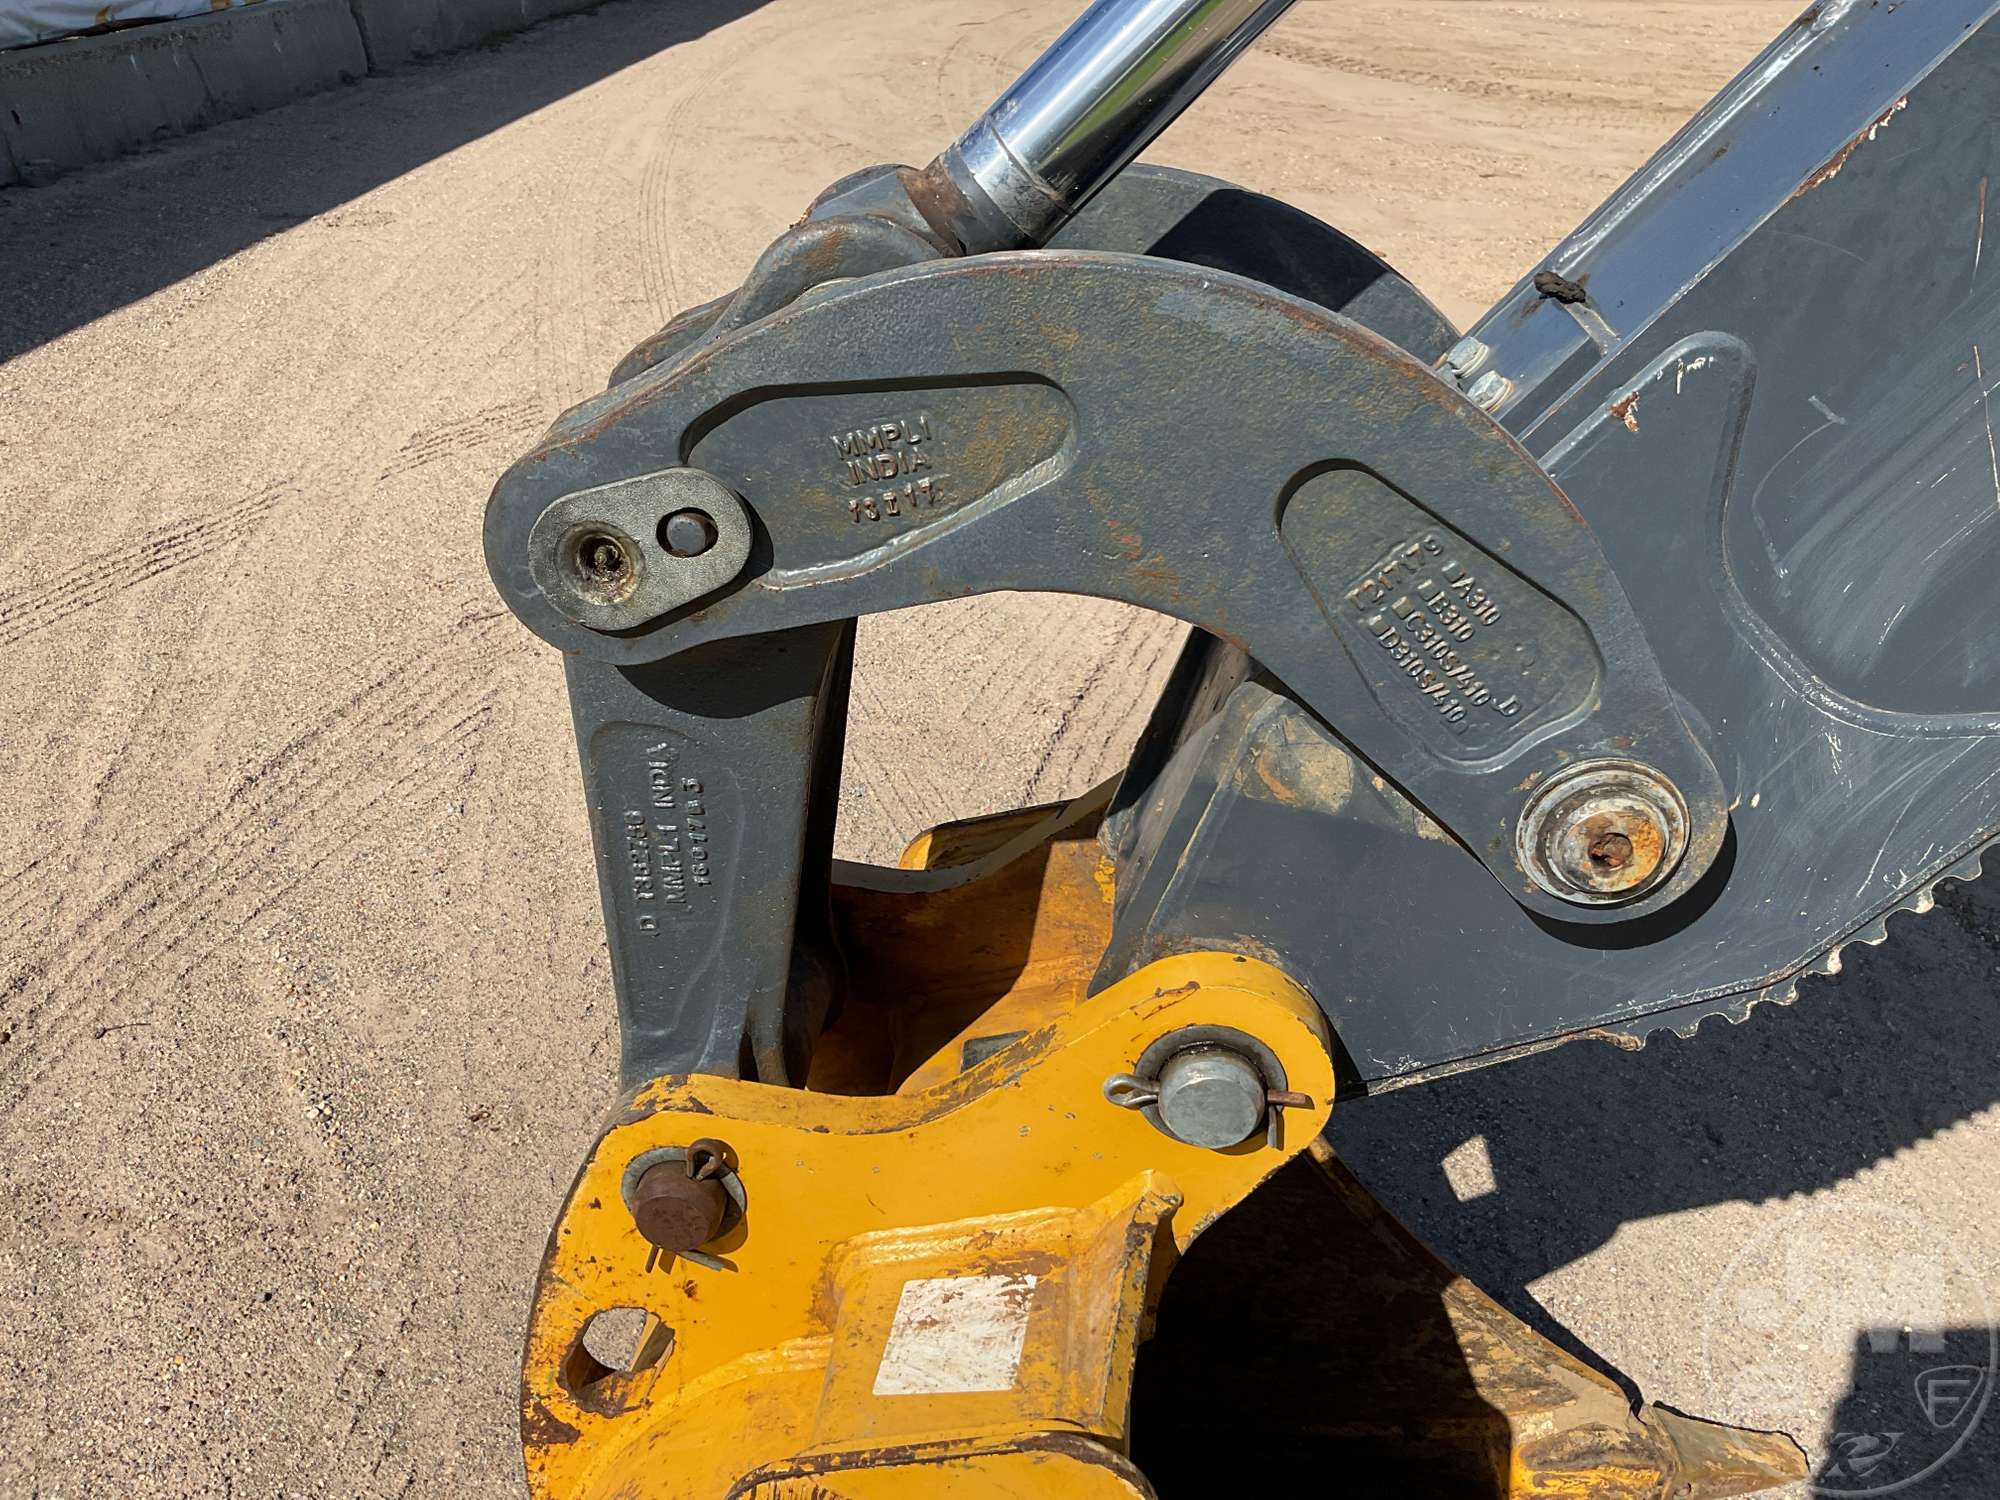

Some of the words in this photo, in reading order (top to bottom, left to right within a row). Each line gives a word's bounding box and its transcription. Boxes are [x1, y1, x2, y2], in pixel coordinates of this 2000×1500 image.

[831, 416, 932, 460] MMPLI
[846, 446, 932, 485] INDIA
[646, 742, 680, 809] INDIA
